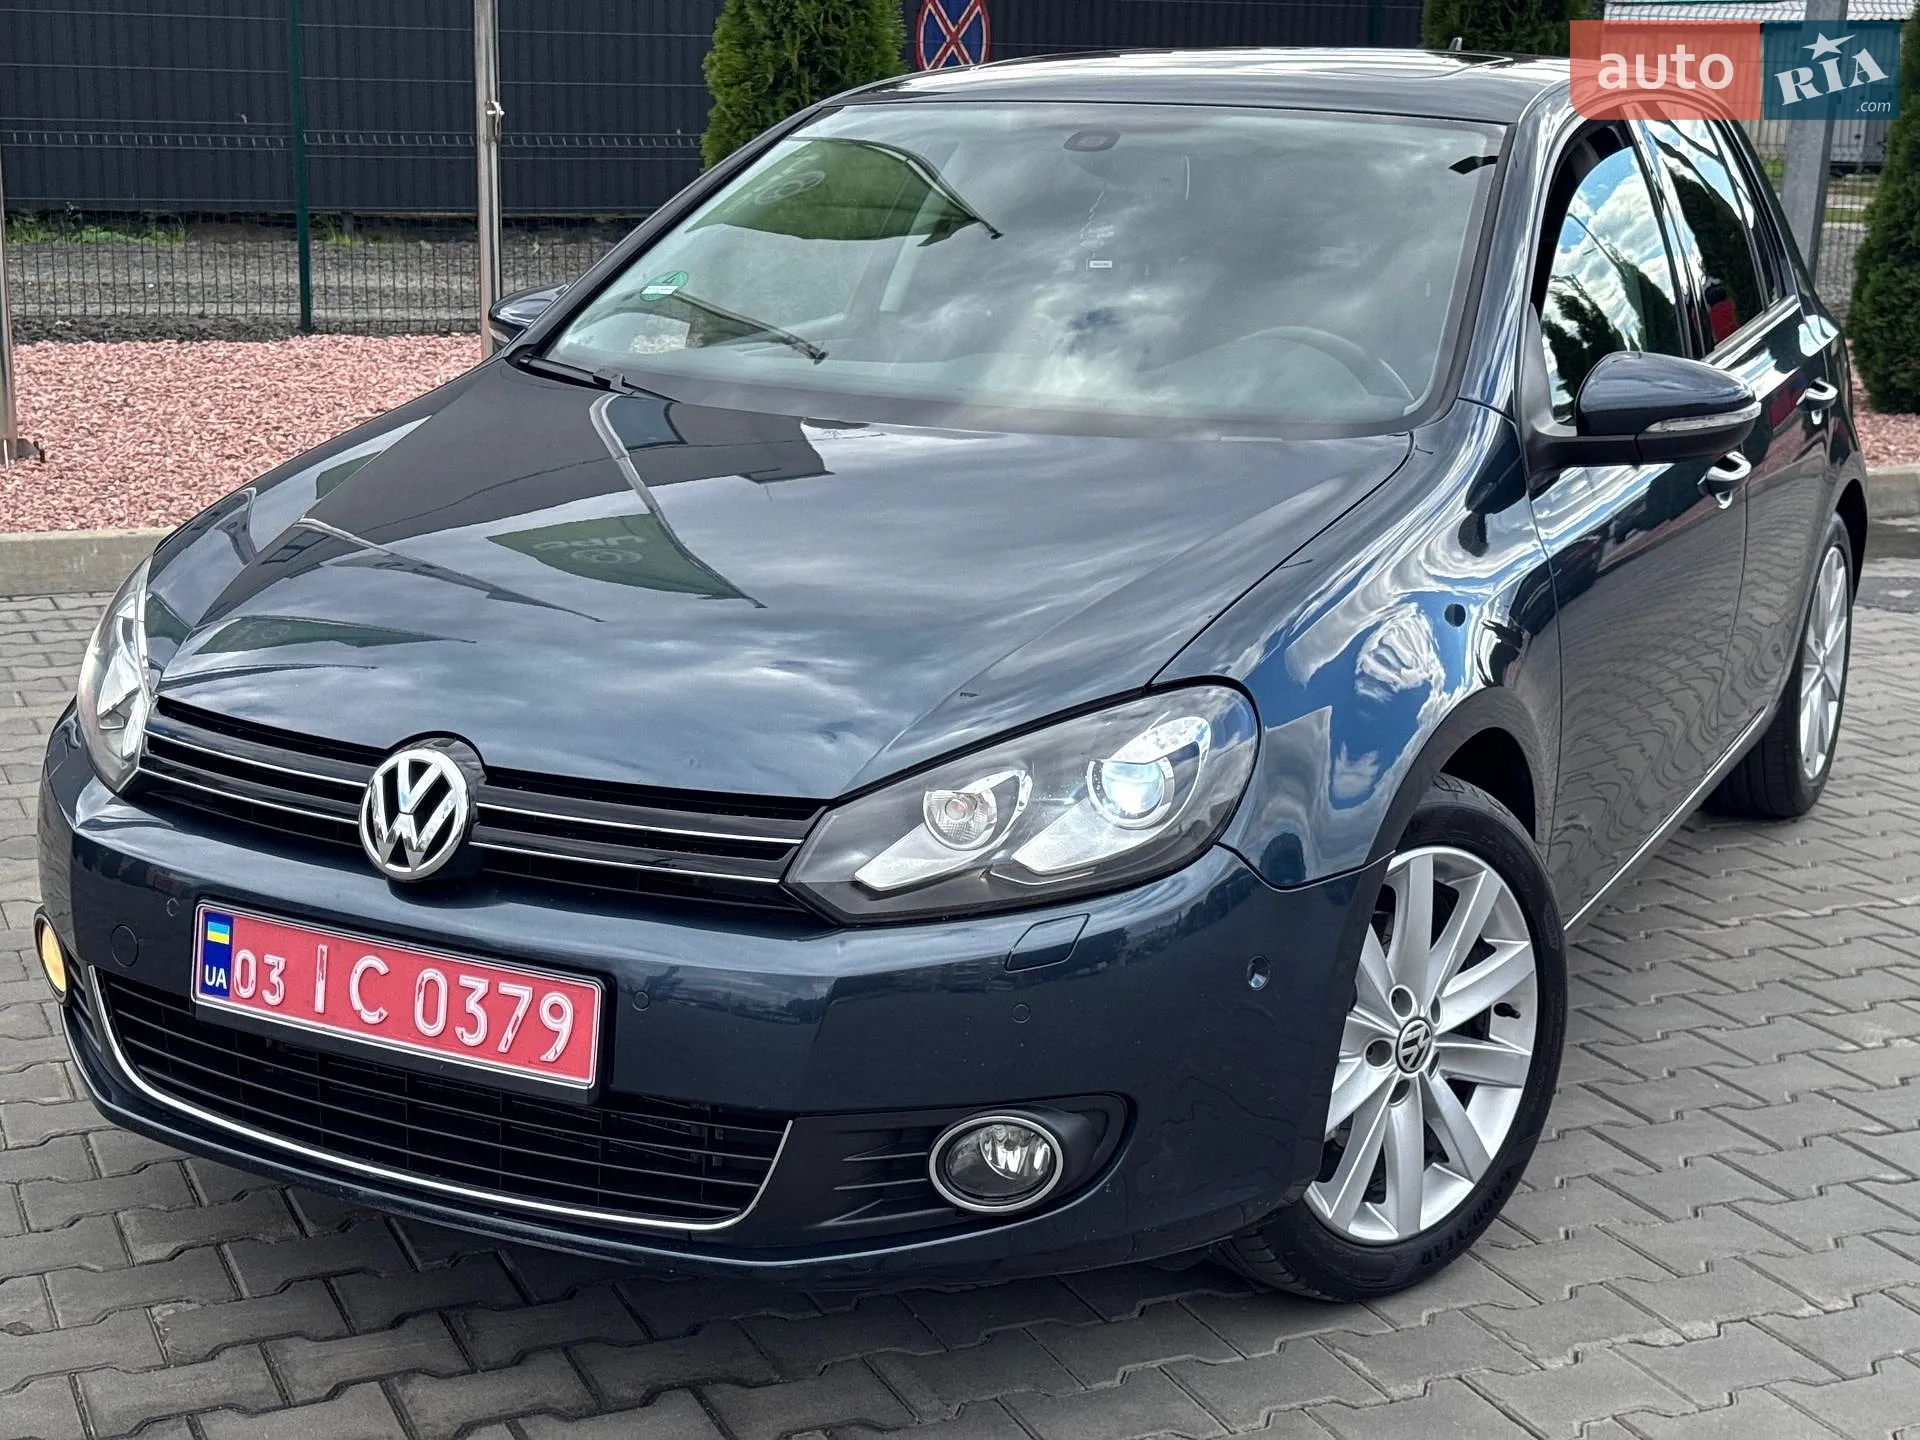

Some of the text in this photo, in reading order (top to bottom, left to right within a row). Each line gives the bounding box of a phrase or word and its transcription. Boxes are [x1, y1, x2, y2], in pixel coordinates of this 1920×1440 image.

[204, 964, 228, 990] UA
[233, 949, 287, 1006] 03
[413, 967, 575, 1063] 0379
